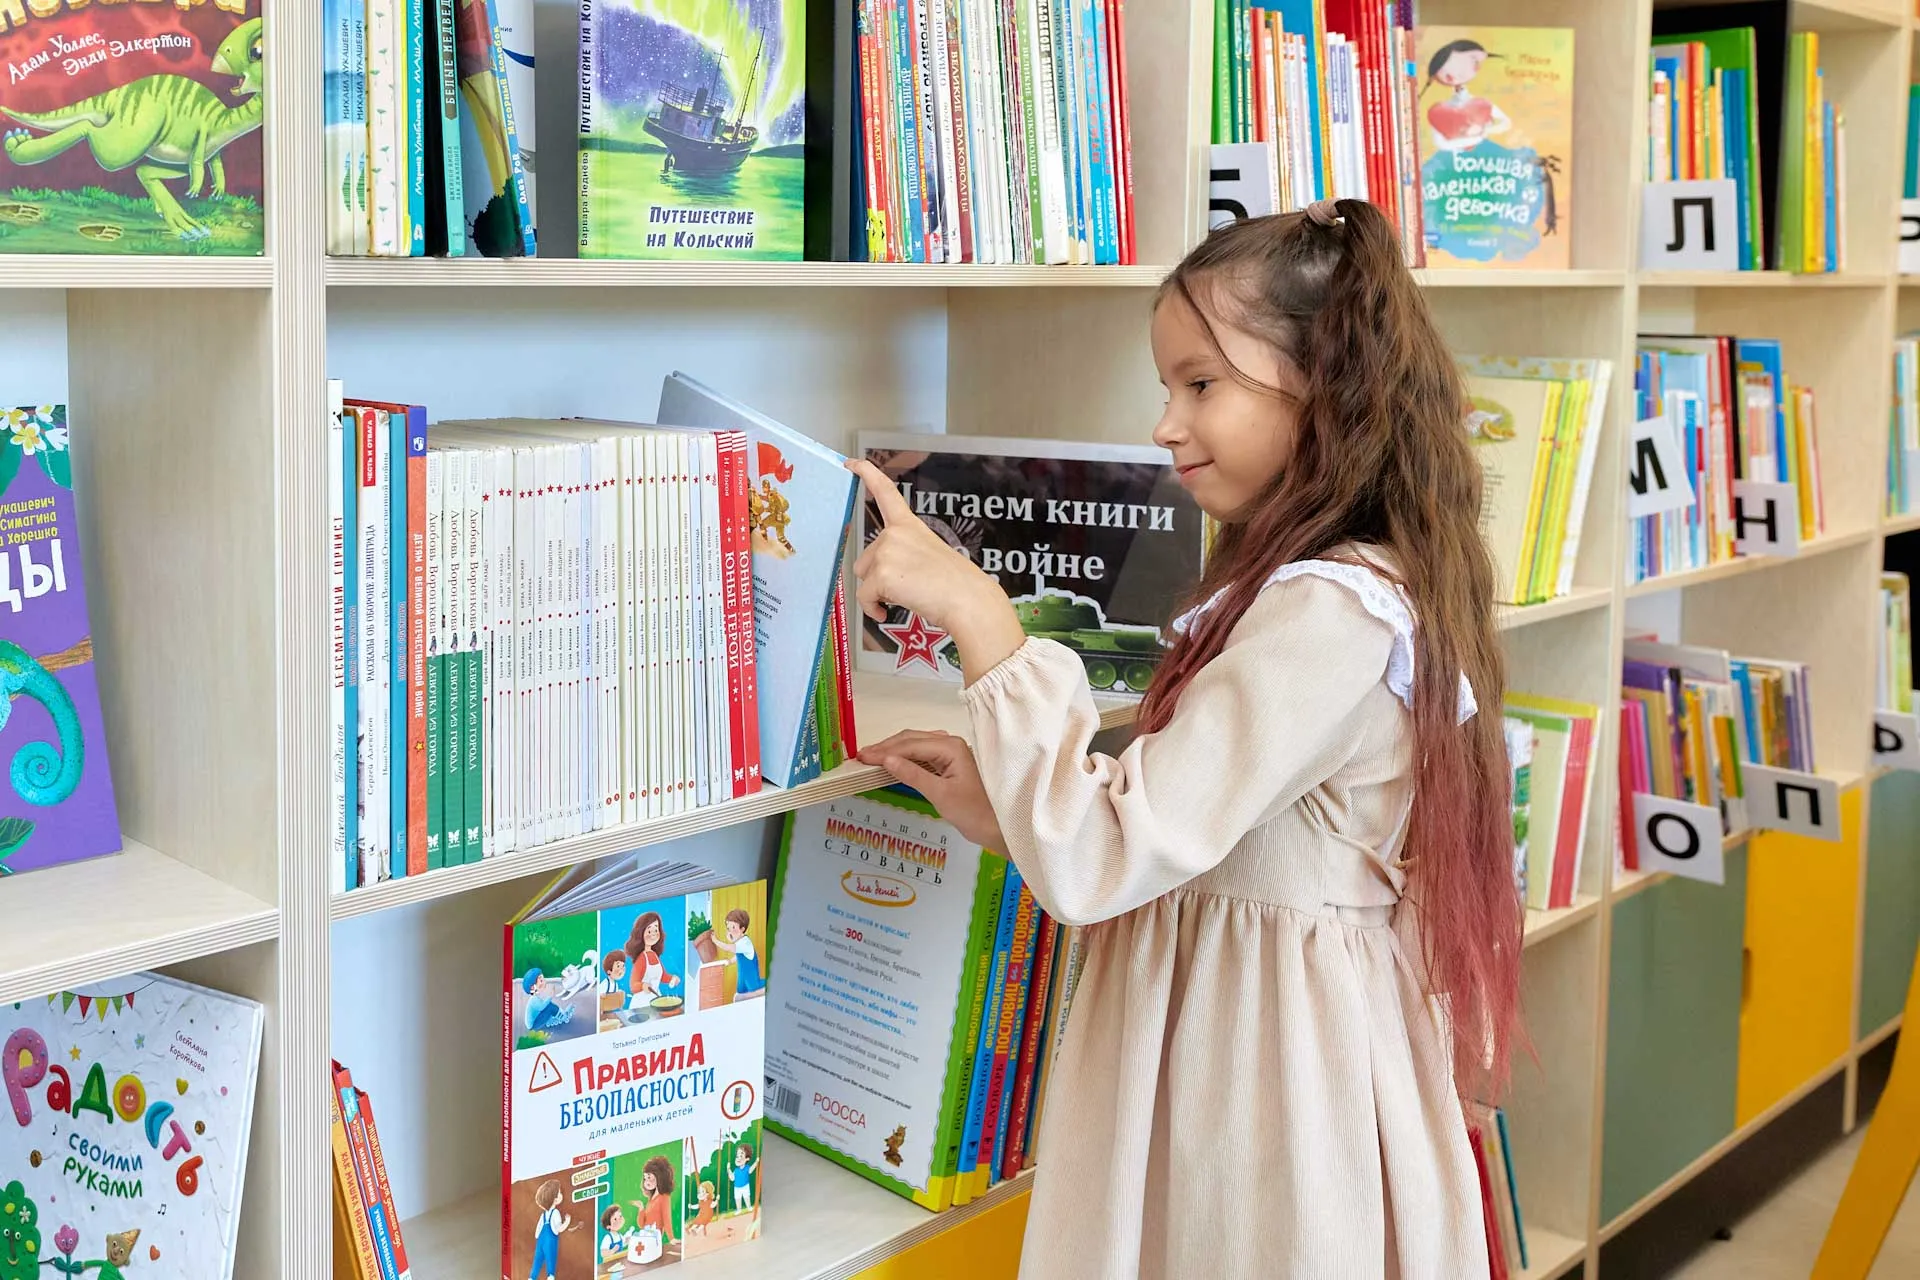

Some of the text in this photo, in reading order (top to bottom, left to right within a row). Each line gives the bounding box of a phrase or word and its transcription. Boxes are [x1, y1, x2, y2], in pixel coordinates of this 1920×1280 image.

[8, 31, 106, 84] Адам Уоллес,
[62, 34, 192, 76] Энди Элкертон
[342, 18, 350, 119] МИХАИЛ ЛУКАШЕВИЧ
[356, 20, 364, 120] МИХАИЛ ЛУКАШЕВИЧ
[919, 13, 931, 86] ГРОЗНУЮ
[936, 18, 947, 86] ОТВАЖНОЕ
[444, 58, 456, 104] БЕЛЫЕ
[499, 78, 516, 135] Мусорный
[1022, 47, 1038, 177] ВЕЛИКИЕ ПОЛКОВОДЦЫ
[951, 51, 969, 213] ВЕЛИКИЕ ПОЛКОВОДЦЫ
[511, 153, 523, 174] Рой
[905, 128, 918, 200] ПОЛКОВОДЦЫ
[1452, 149, 1534, 180] Большая
[515, 179, 527, 204] Олег
[1445, 197, 1530, 223] девочка
[581, 201, 589, 246] Варвара
[1666, 197, 1715, 252] Л
[381, 453, 389, 482] войны
[0, 511, 57, 531] Симагина
[381, 485, 389, 556] Отечественной
[1046, 498, 1175, 532] книги
[1734, 497, 1777, 543] Н
[413, 533, 424, 562] ДЕТЯМ
[448, 510, 461, 631] Любовь Воронкова
[467, 509, 480, 629] Любовь Воронкова
[982, 542, 1105, 581] войне
[381, 559, 389, 598] Великой
[414, 576, 425, 615] ВЕЛИКОЙ
[427, 512, 440, 634] Любовь Воронкова
[725, 551, 738, 608] ЮНЫЕ
[739, 550, 752, 607] ЮНЫЕ
[727, 612, 739, 669] ГЕРОИ
[741, 611, 754, 665] ГЕРОИ
[839, 604, 847, 634] ВЕЛИКОЙ
[366, 525, 375, 796] Сергей Алексеев РАССКАЗЫ ОБ ОБОРОНЕ ЛЕНИНГРАДА
[414, 619, 425, 687] ОТЕЧЕСТВЕННОЙ
[843, 642, 851, 674] РАССКАЗЫ
[333, 517, 345, 852] Николай Богданов БЕССМЕРТНЫЙ ГОРНИСТ
[414, 690, 425, 719] ВОЙНЕ
[427, 664, 438, 777] ДЕВОЧКА ИЗ ГОРОДА
[448, 661, 459, 774] ДЕВОЧКА ИЗ ГОРОДА
[468, 659, 478, 770] ДЕВОЧКА ИЗ ГОРОДА
[830, 803, 948, 845] БОЛЬШОЙ
[1775, 781, 1823, 827] П
[826, 817, 948, 871] МИФОЛОГИЧЕСКИЙ
[1646, 812, 1700, 860] О
[824, 838, 942, 885] СЛОВАРЬ
[856, 876, 872, 893] для
[845, 927, 863, 942] 300
[995, 982, 1019, 1055] ПОСЛОВИЦ
[1010, 886, 1034, 964] ПОГОВОРОК
[1035, 952, 1050, 1016] ГРАММАТИКА
[1063, 942, 1079, 1004] БОЛЬШАЯ
[966, 954, 989, 1054] МИФОЛОГИЧЕСКИЙ
[985, 950, 1008, 1049] ФРАЗЕОЛОГИЧЕСКИЙ
[169, 1044, 206, 1073] Короткова
[175, 1029, 208, 1058] Светлана
[573, 1033, 705, 1095] ПРАВИЛА
[612, 1031, 670, 1049] Татьяна Григорьян
[559, 1067, 715, 1130] БЕЗОПАСНОСТИ
[588, 1105, 693, 1141] для маленьких детей
[813, 1091, 866, 1128] РООССА
[68, 1132, 143, 1172] своими
[358, 1146, 371, 1179] НАТАЛЬЯ
[367, 1123, 388, 1183] ЭНЦИКЛОПЕДИЯ
[63, 1156, 143, 1199] руками
[340, 1151, 370, 1253] КАК МИШКА НОВИКОВ
[582, 1187, 599, 1198] СВОИ
[373, 1208, 385, 1237] УЧИМСЯ
